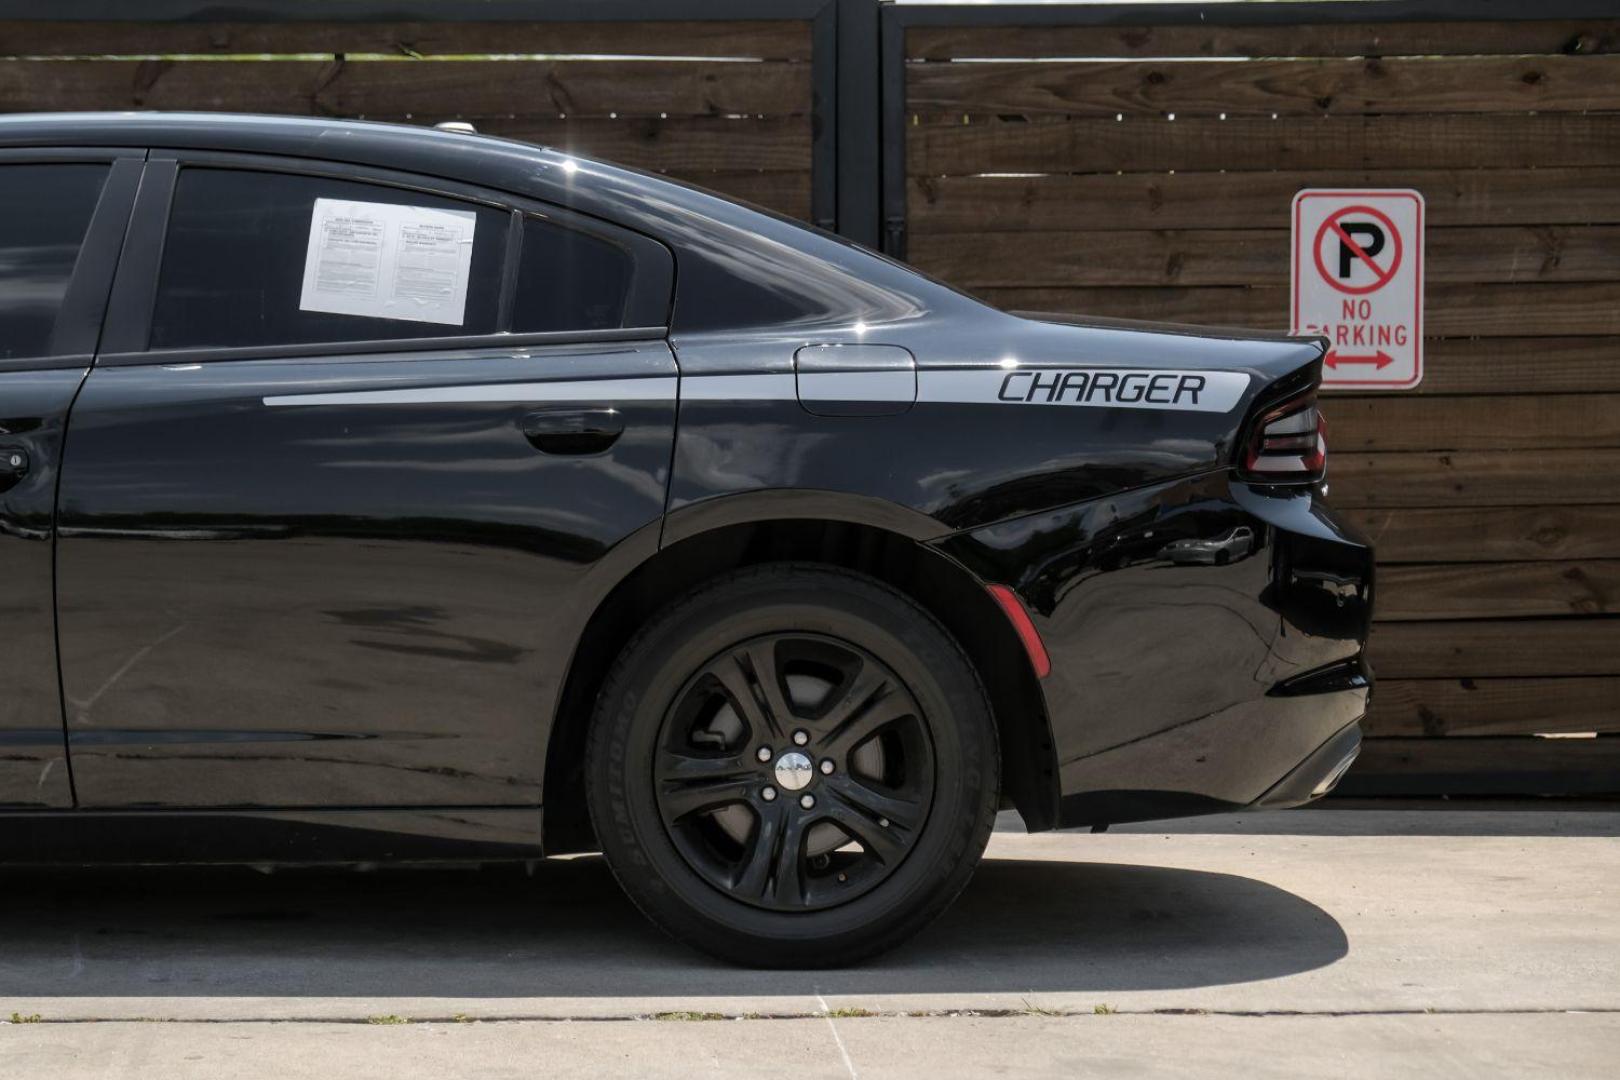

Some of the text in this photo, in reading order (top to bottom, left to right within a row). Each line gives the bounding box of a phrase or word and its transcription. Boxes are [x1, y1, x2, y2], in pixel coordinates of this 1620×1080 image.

[1342, 299, 1372, 320] NO
[1306, 324, 1407, 346] RKING
[998, 372, 1206, 405] CHARGER
